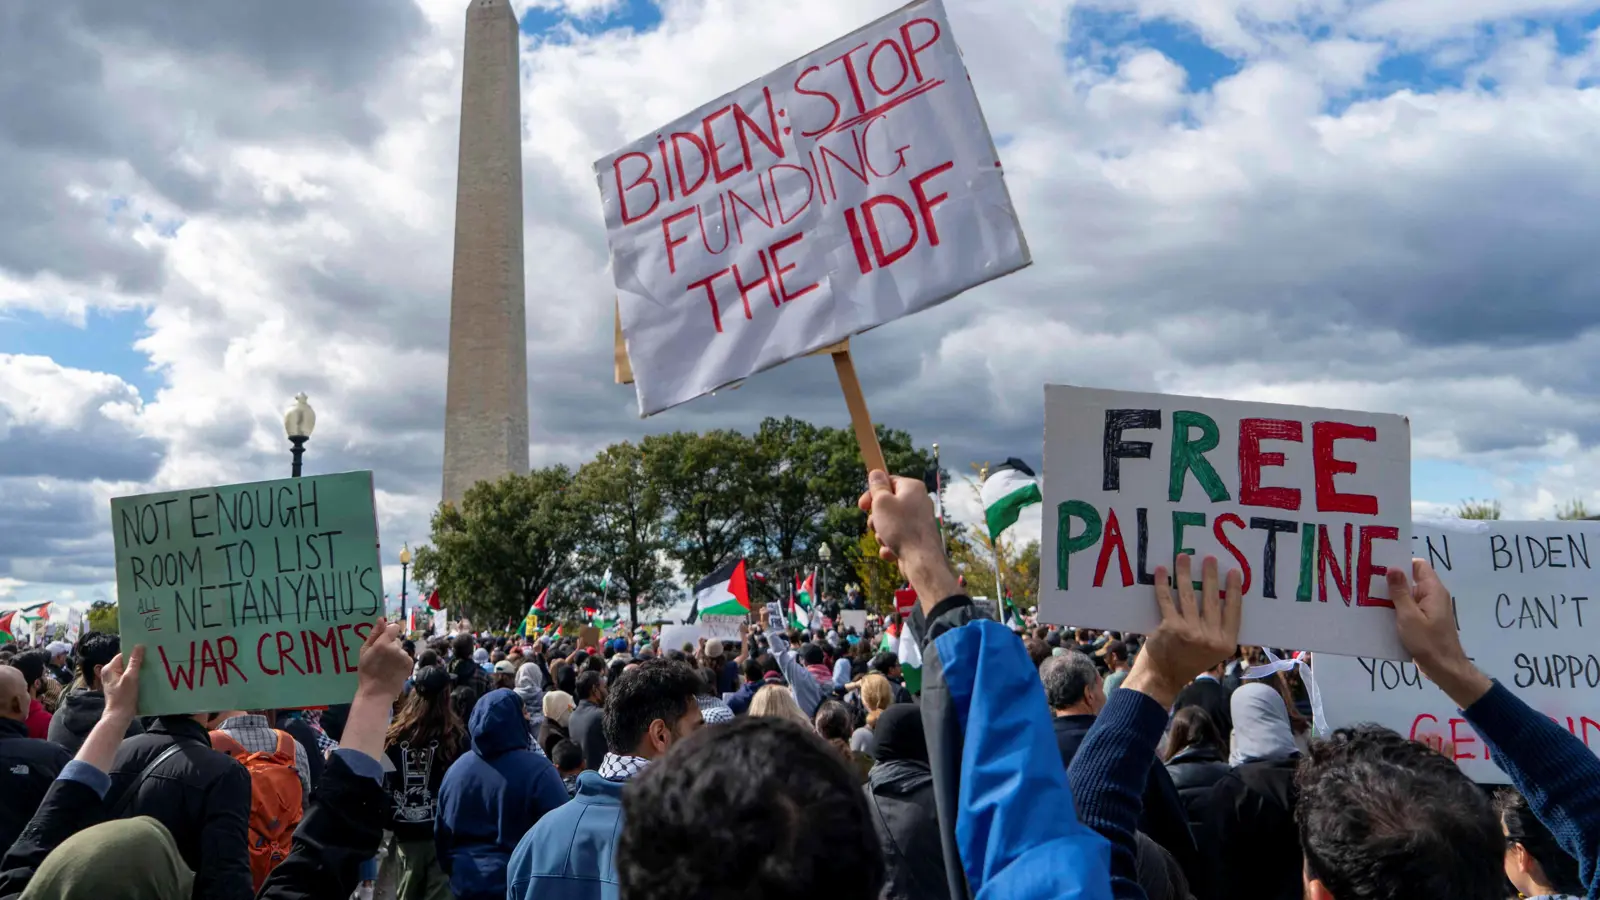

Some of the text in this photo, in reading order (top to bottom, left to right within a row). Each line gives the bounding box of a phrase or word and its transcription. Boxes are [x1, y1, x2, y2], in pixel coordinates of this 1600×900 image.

[794, 18, 941, 137] STOP
[662, 115, 910, 275] FUNDING
[687, 161, 954, 333] THE IDF
[1102, 408, 1379, 515] FREE
[121, 480, 319, 548] NOT ENOUGH
[131, 530, 342, 592] ROOM TO LIST
[1055, 499, 1399, 609] PALESTINE
[1490, 532, 1591, 573] BIDEN
[137, 595, 161, 614] ALL
[144, 613, 161, 629] OF
[174, 565, 378, 633] NETANYAHU'S
[1495, 593, 1588, 629] CAN'T
[158, 635, 248, 691] WAR
[1513, 652, 1600, 688] SUPPO
